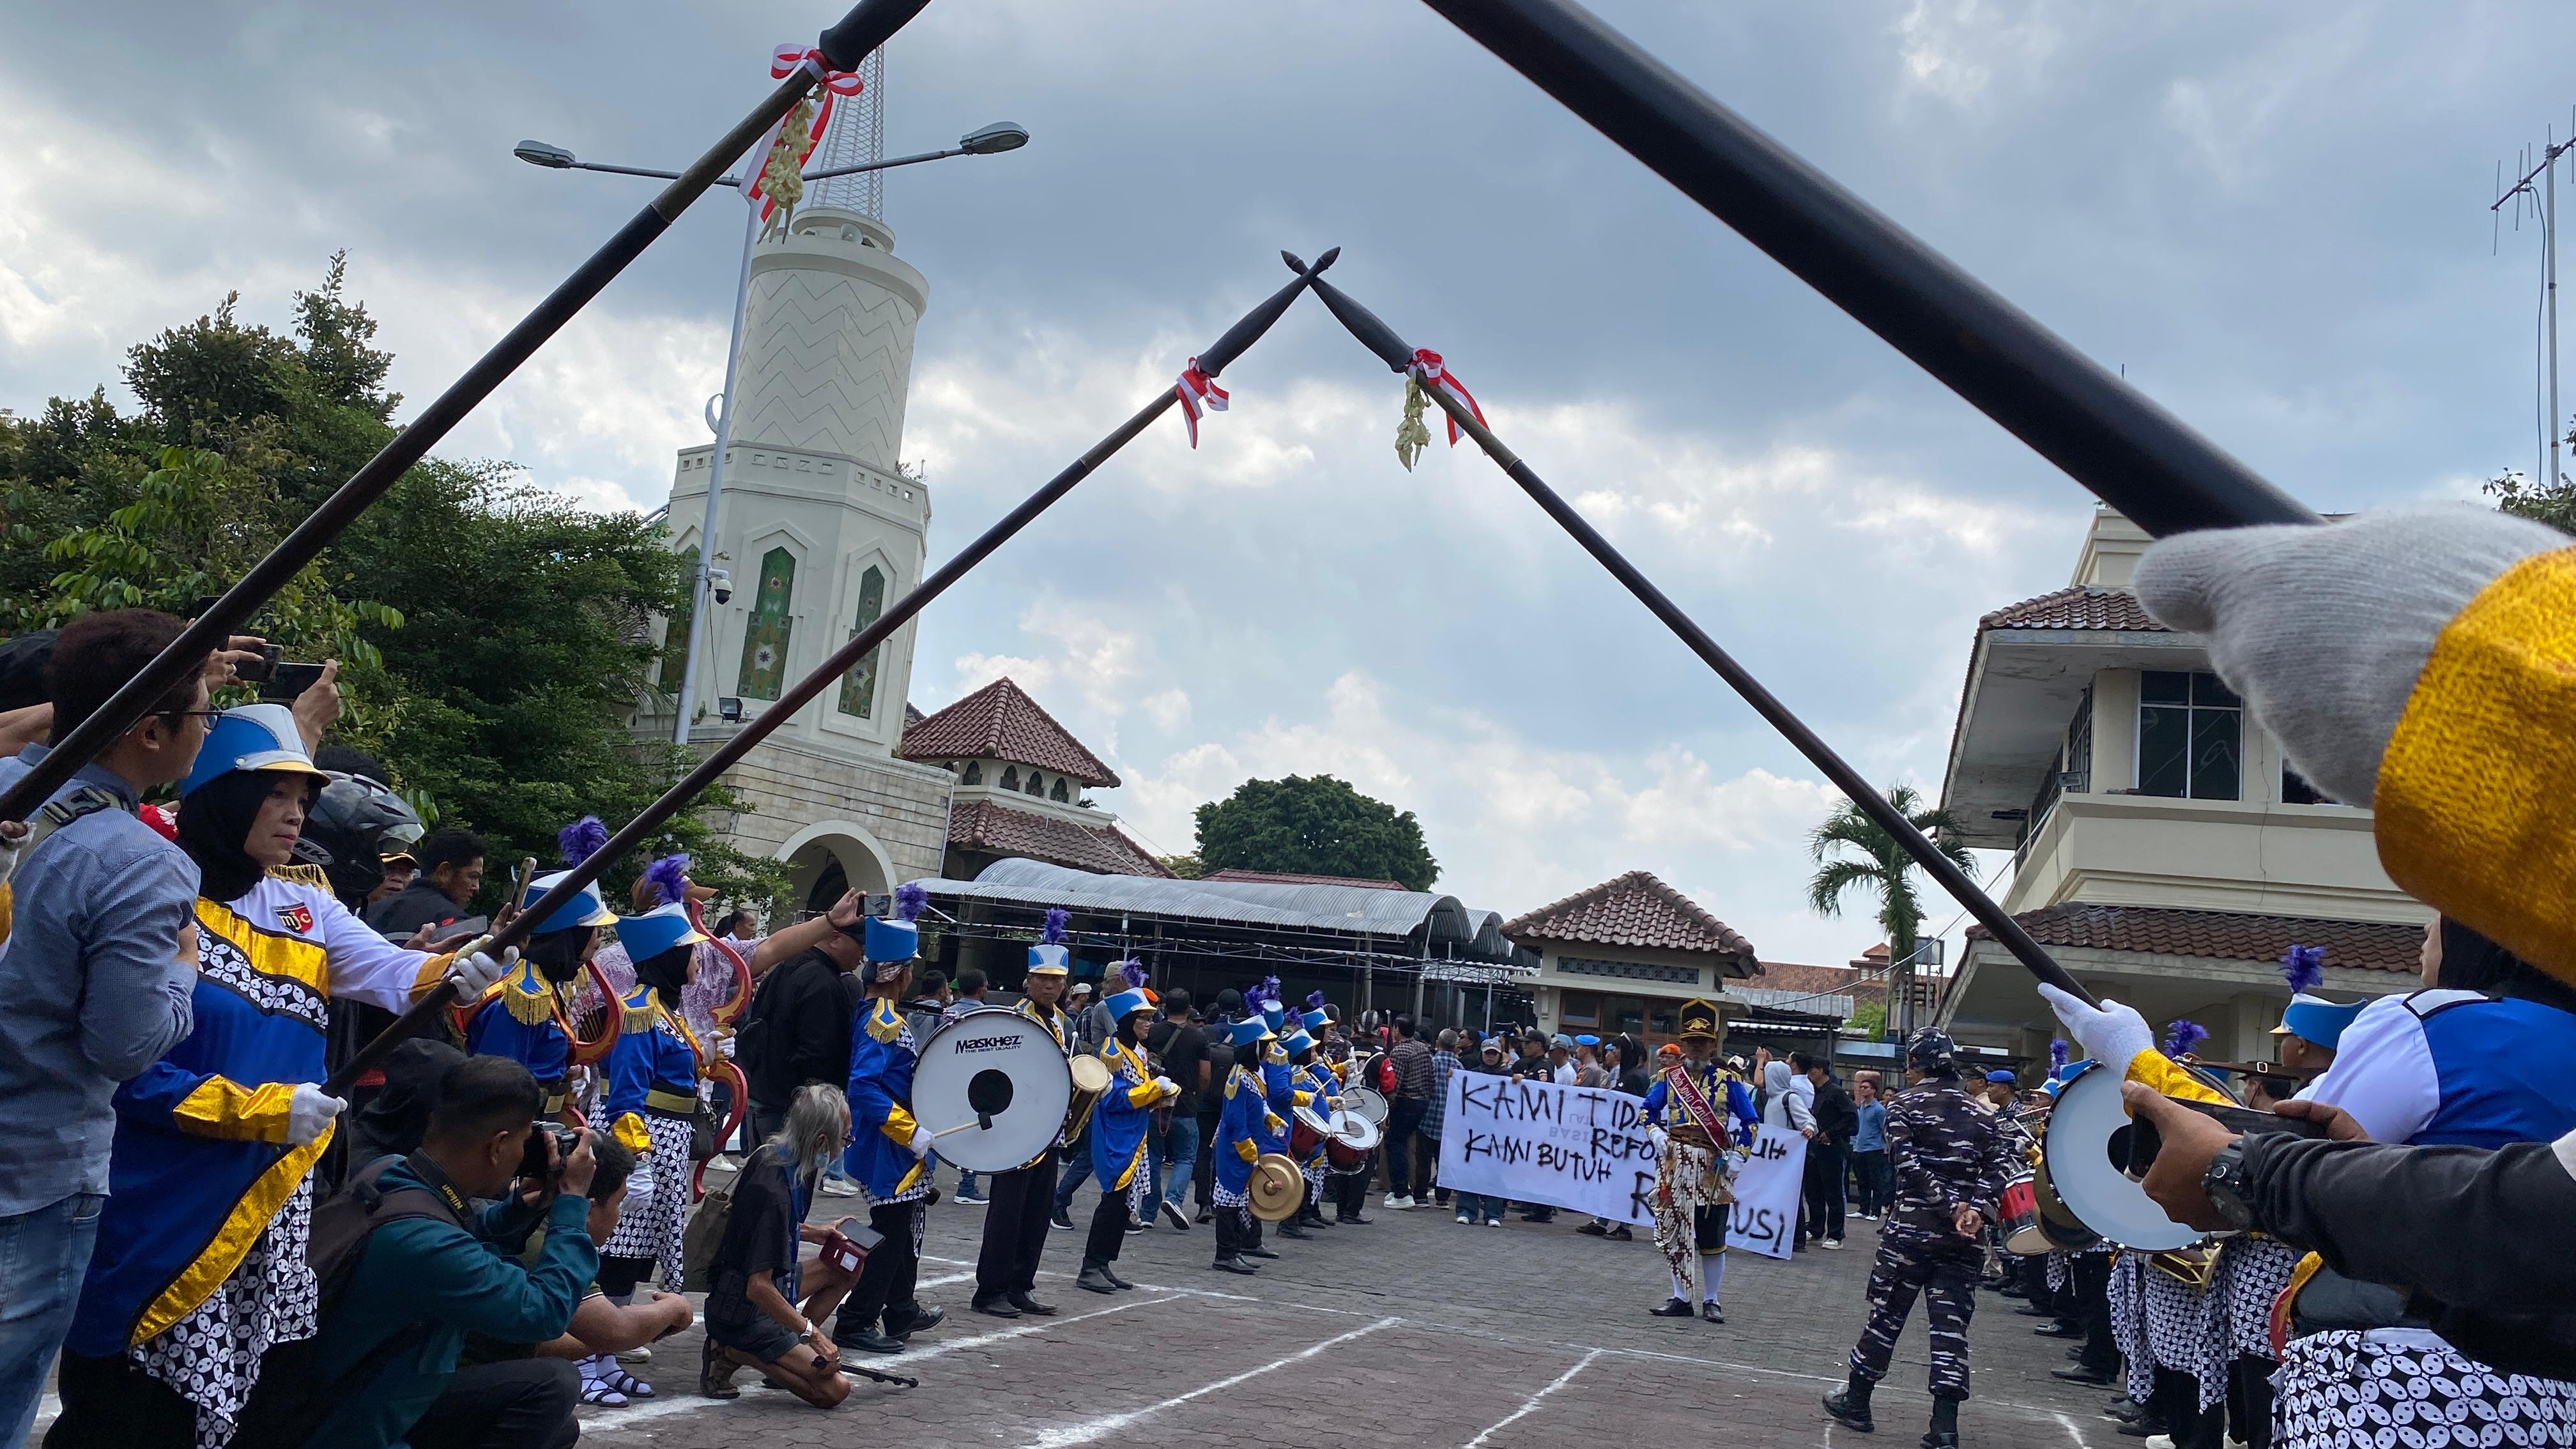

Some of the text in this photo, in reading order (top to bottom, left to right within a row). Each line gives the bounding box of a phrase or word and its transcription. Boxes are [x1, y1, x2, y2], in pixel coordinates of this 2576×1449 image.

[1462, 1076, 1564, 1124] KAMI
[1690, 1099, 1713, 1126] Center
[1465, 1128, 1531, 1165] KAMI
[1538, 1142, 1611, 1183] BUTUH
[1590, 1128, 1660, 1168] REFO
[441, 1184, 463, 1209] Nikon
